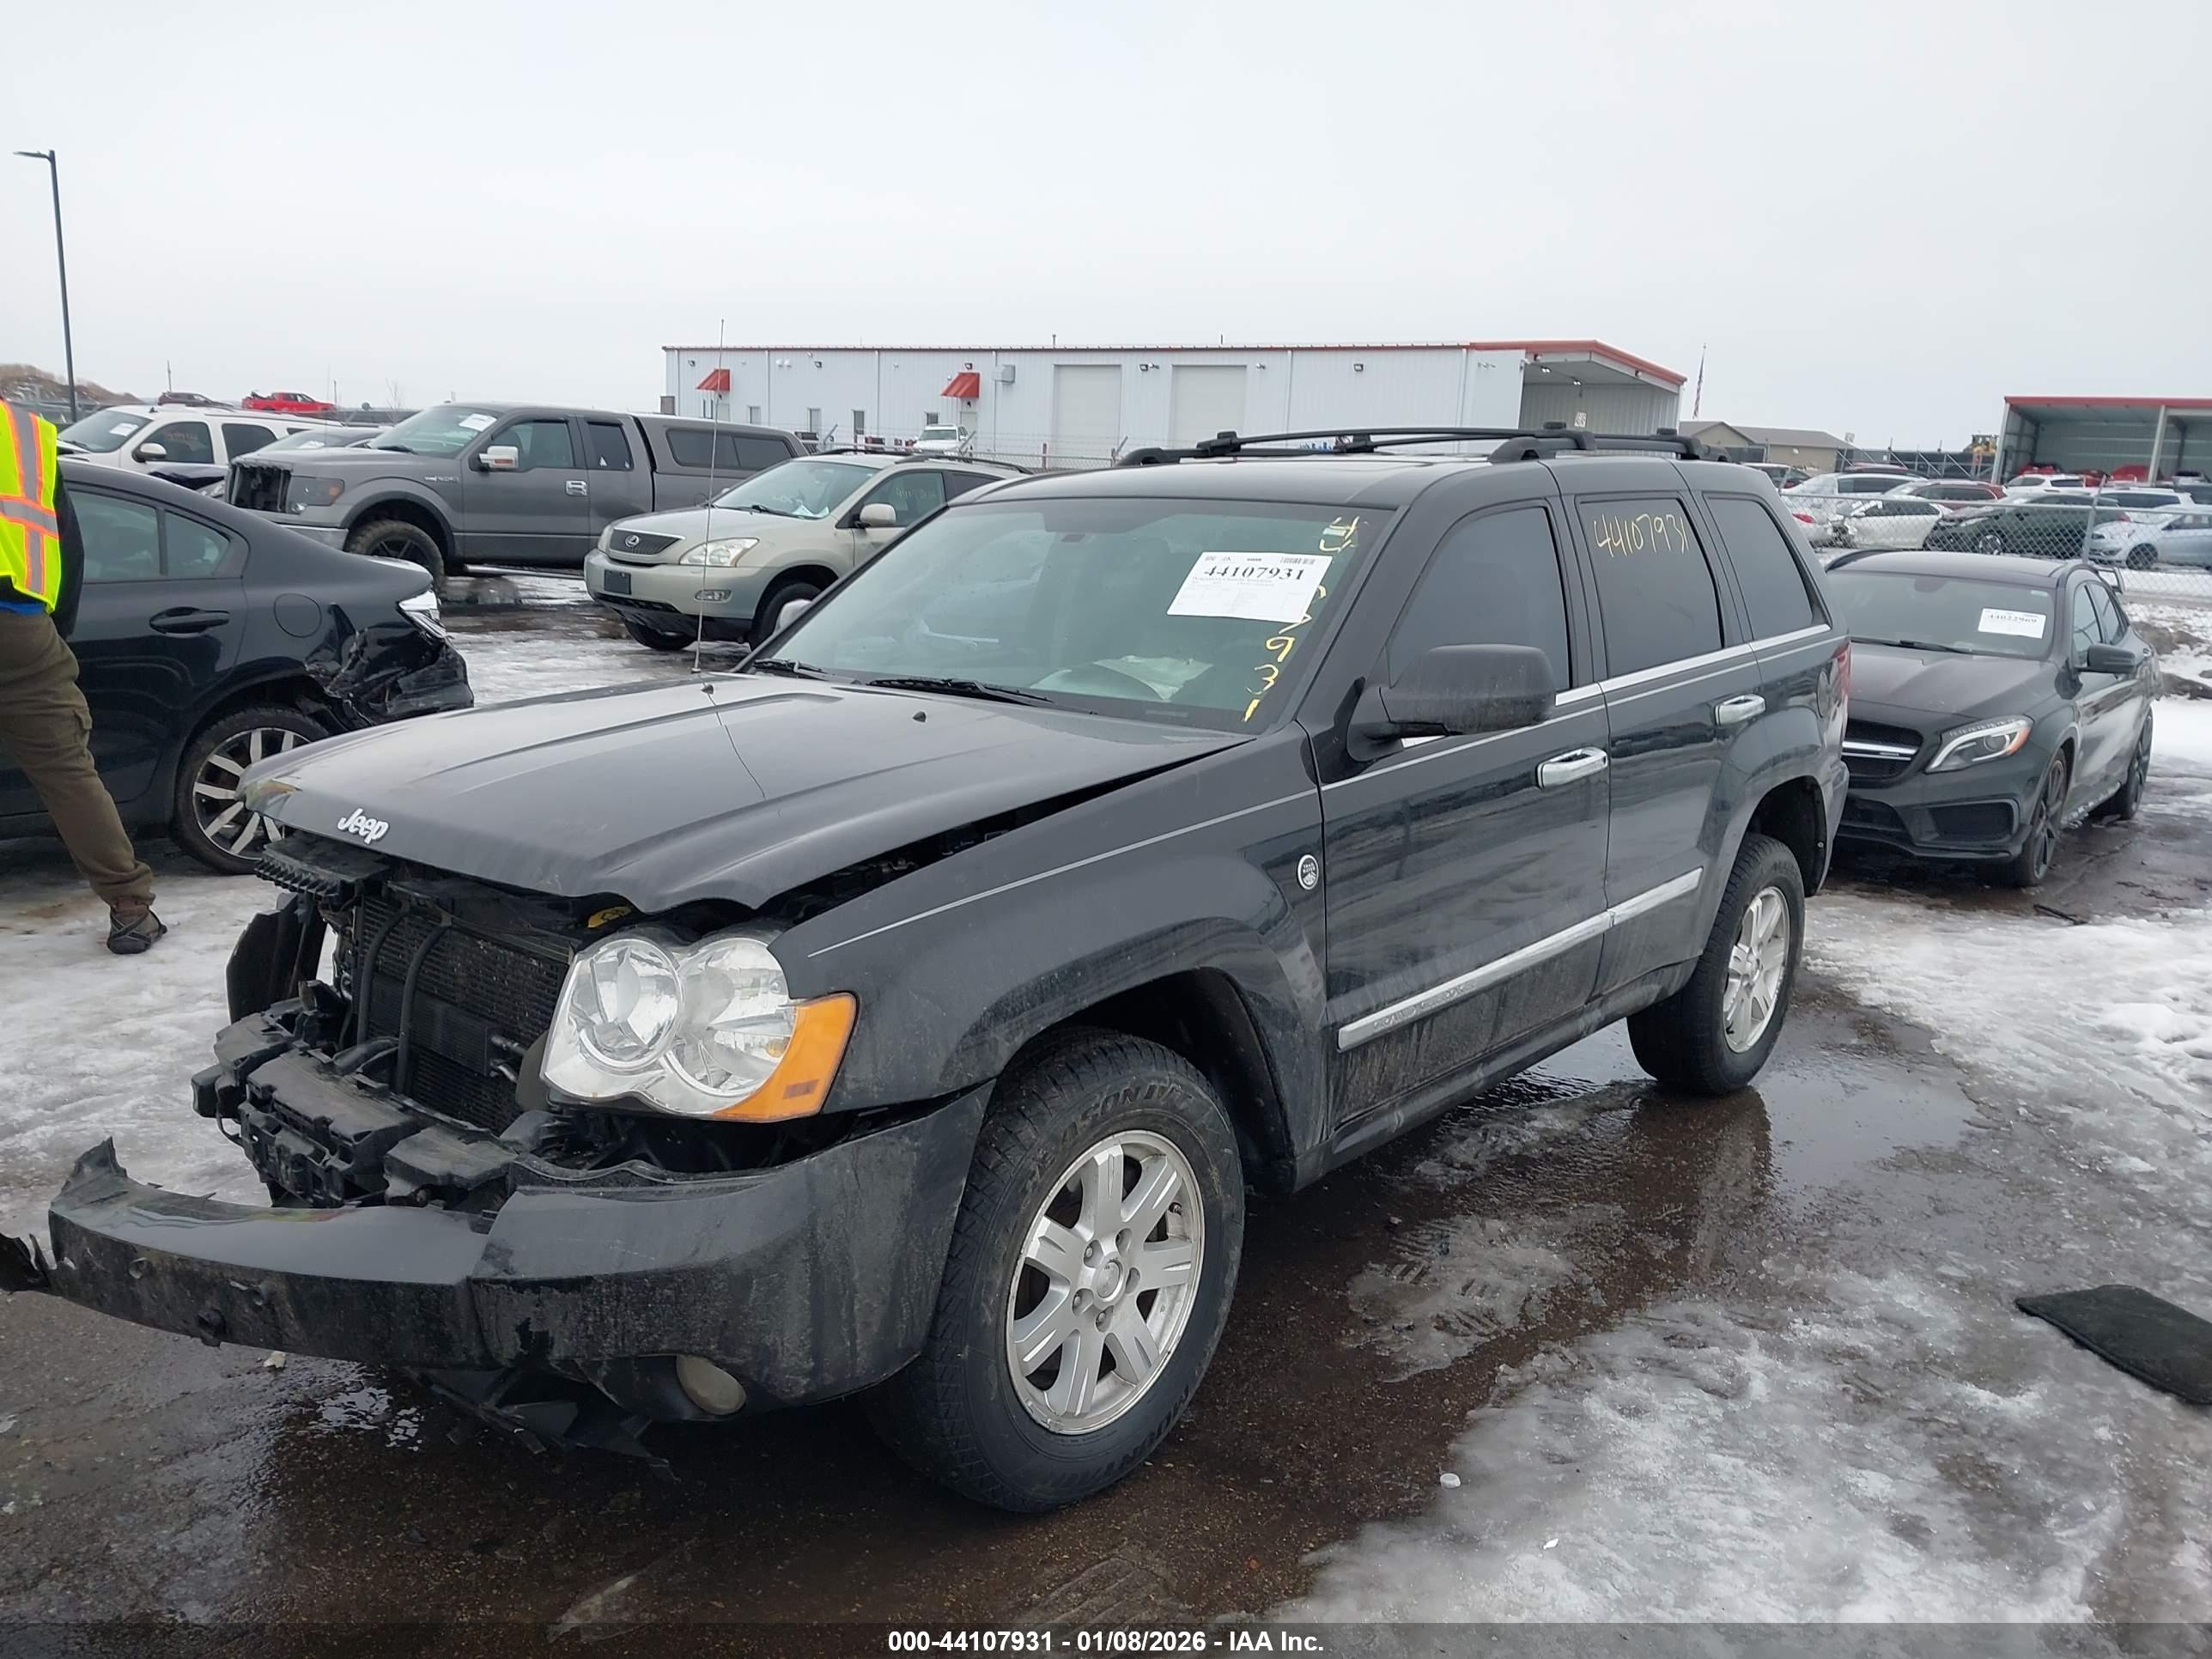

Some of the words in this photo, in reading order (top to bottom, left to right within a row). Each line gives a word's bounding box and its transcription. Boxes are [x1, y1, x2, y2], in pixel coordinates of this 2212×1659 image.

[1593, 514, 1689, 557] 44107931
[1204, 565, 1305, 581] 44107931
[337, 808, 389, 845] Jeep
